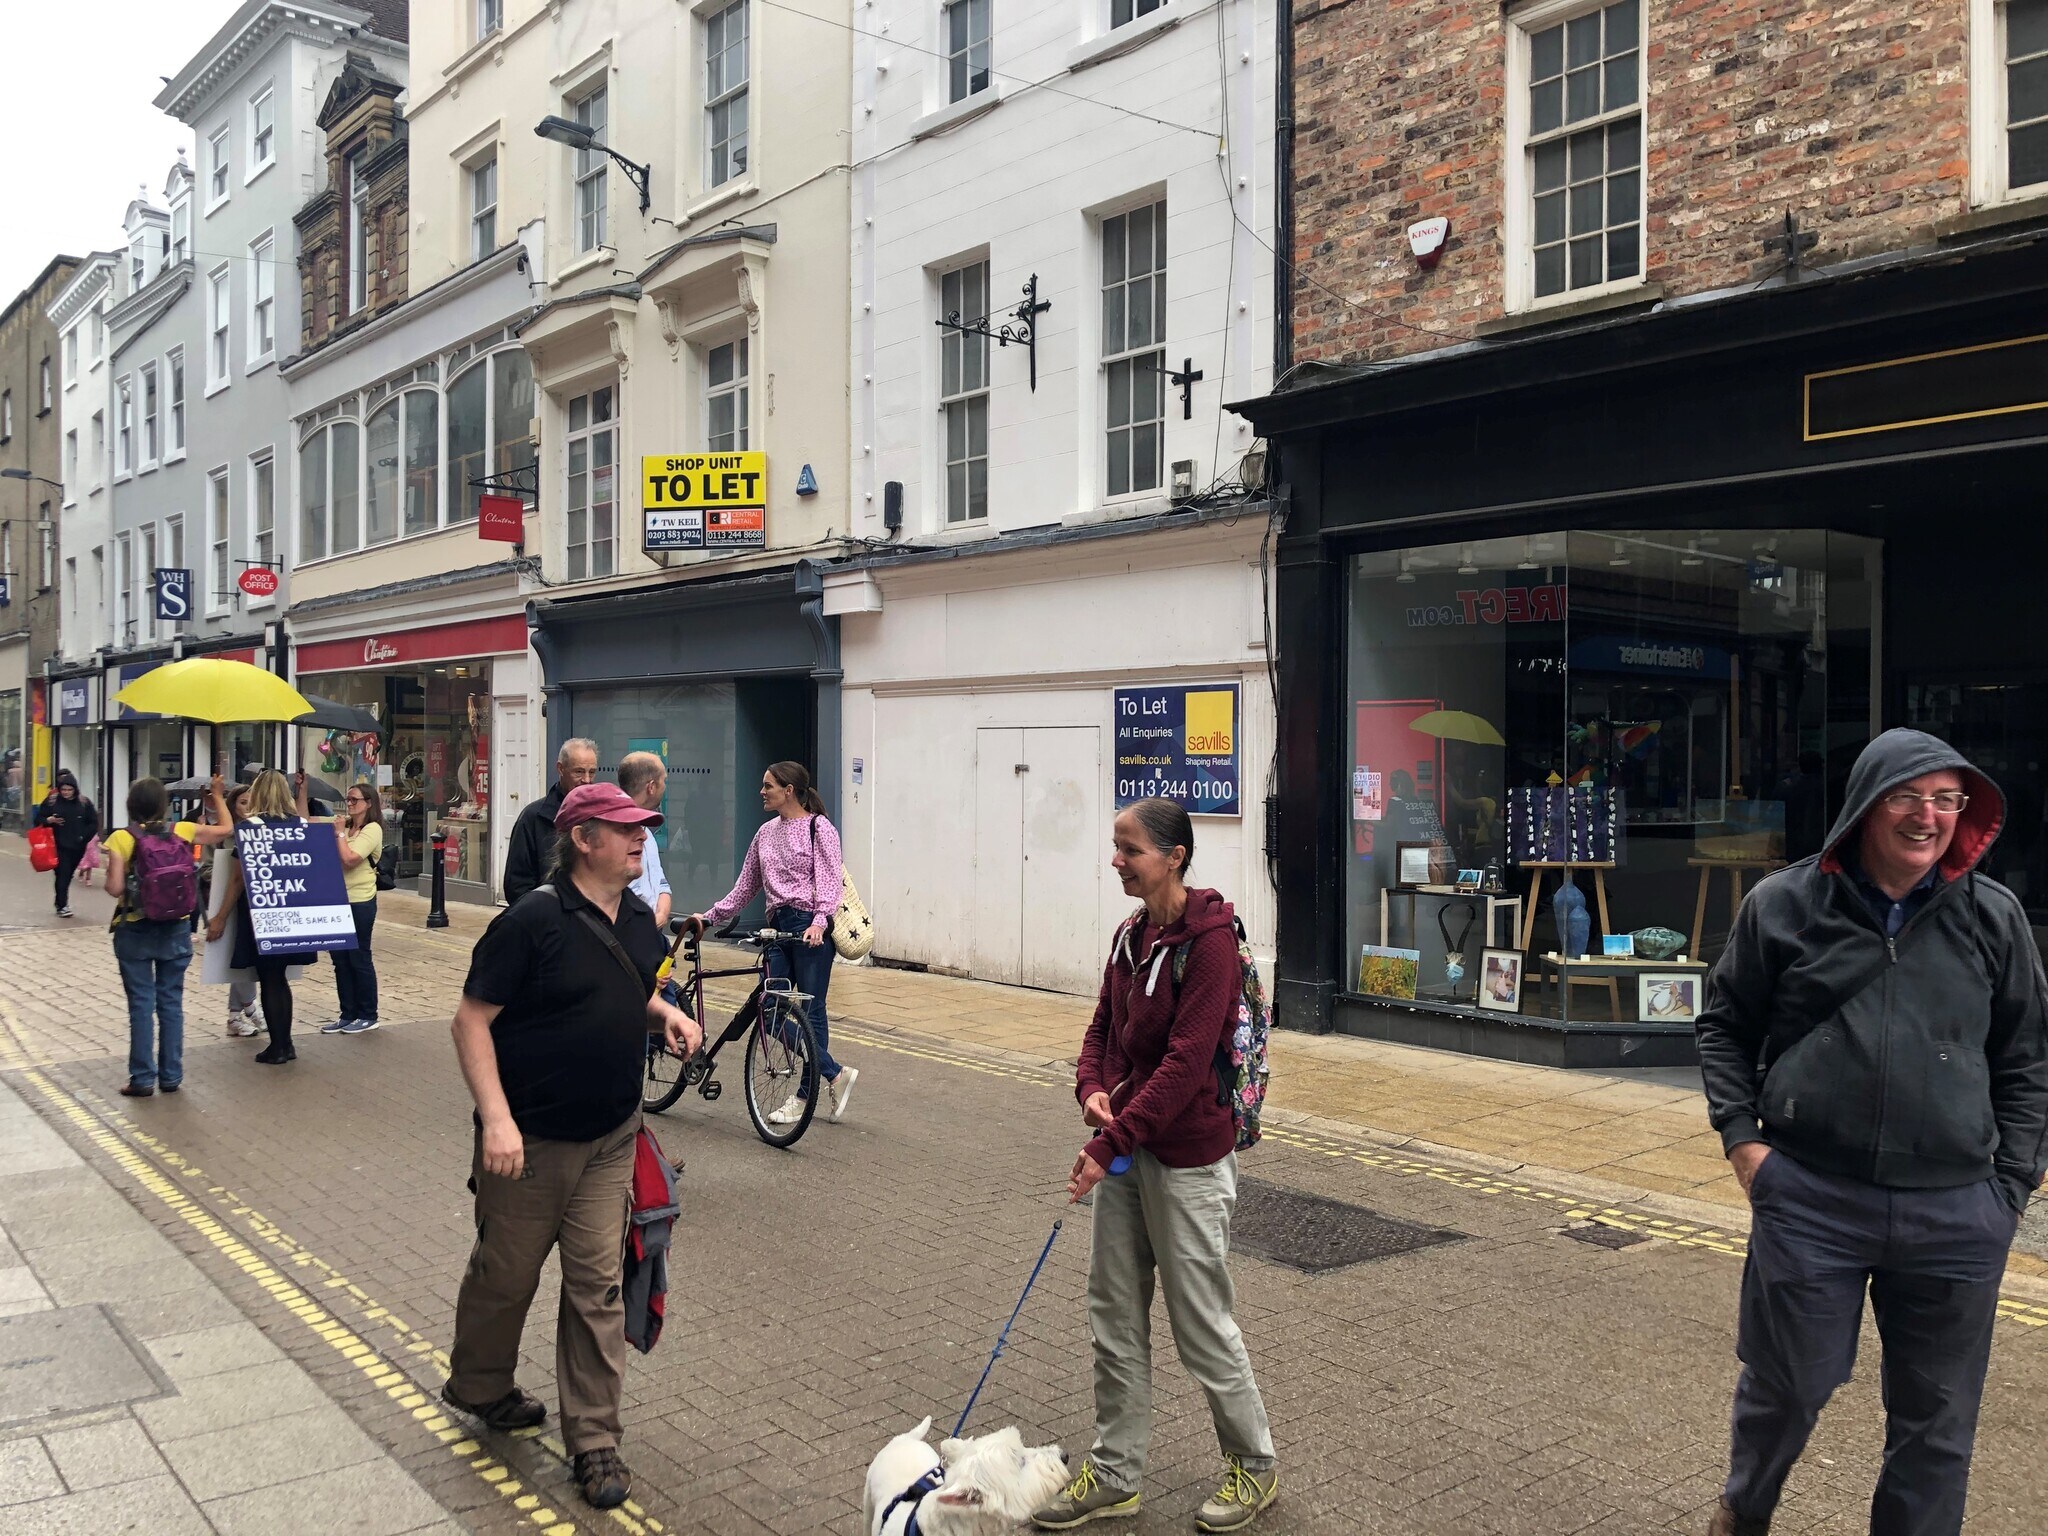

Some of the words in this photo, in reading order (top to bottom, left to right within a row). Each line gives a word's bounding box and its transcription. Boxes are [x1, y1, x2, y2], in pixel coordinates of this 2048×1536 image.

[1412, 226, 1439, 239] KINGS
[666, 458, 704, 471] SHOP
[709, 457, 742, 469] UNIT
[649, 474, 691, 502] TO
[703, 472, 760, 500] LET
[484, 512, 516, 525] Clintons
[678, 518, 699, 526] KEIL
[648, 531, 666, 541] 0203
[667, 529, 681, 541] 883
[682, 529, 701, 541] 9024
[708, 531, 726, 539] 0113
[728, 531, 742, 539] 244
[160, 572, 184, 583] WH
[249, 573, 271, 582] POST
[244, 581, 274, 590] OFFICE
[161, 582, 187, 617] S
[364, 638, 399, 662] Clintons
[1119, 697, 1138, 716] To
[1142, 696, 1167, 715] Let
[1119, 727, 1130, 738] All
[1133, 726, 1173, 740] Enquiries
[1187, 731, 1231, 751] savills
[1119, 754, 1172, 765] savills.co.uk
[1185, 757, 1211, 767] Shaping
[1212, 758, 1232, 766] Retail.
[1120, 779, 1156, 797] 0113
[1160, 780, 1187, 798] 244
[1192, 781, 1232, 800] 0100
[239, 827, 306, 841] NURSES
[243, 841, 275, 854] ARE
[245, 853, 312, 867] SCARED
[246, 866, 272, 880] TO
[250, 878, 306, 894] SPEAK
[252, 893, 287, 907] OUT
[253, 911, 300, 920] COERCION
[255, 919, 263, 927] IS
[265, 918, 284, 926] NOT
[287, 917, 303, 925] THE
[331, 915, 342, 923] AS
[255, 926, 291, 934] CARING
